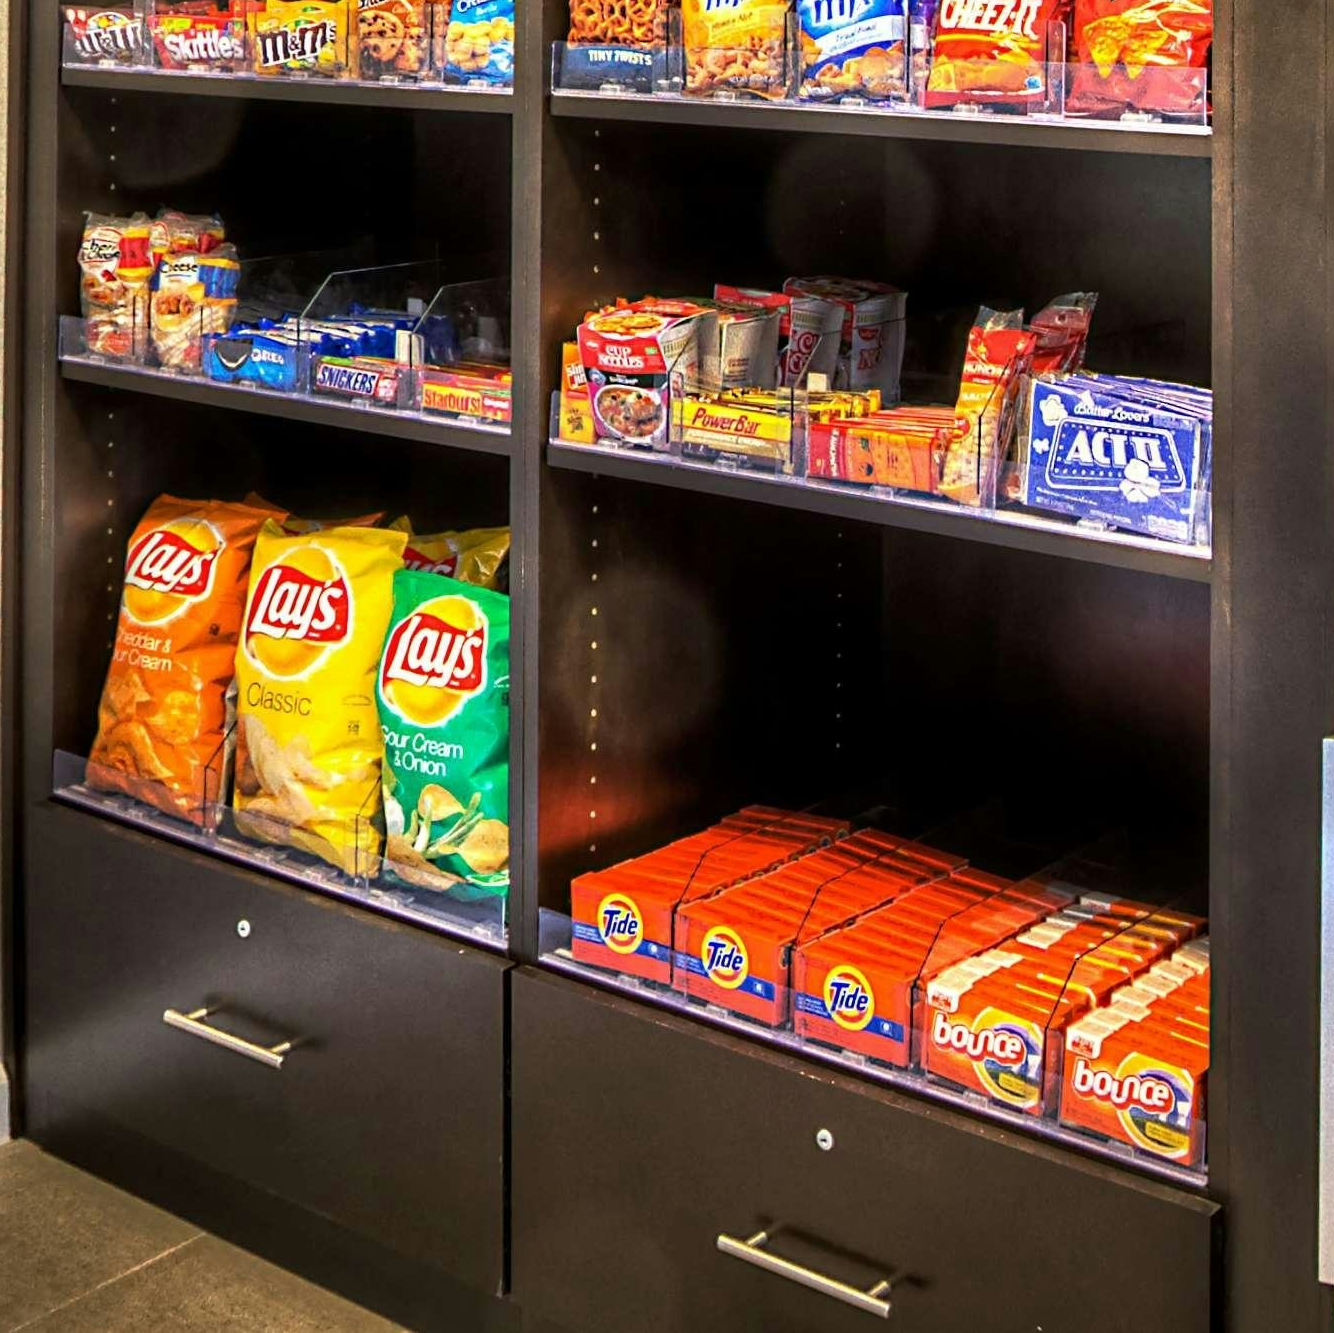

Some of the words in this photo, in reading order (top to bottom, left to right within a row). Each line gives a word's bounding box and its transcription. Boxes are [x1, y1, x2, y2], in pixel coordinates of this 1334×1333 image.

[164, 29, 245, 60] Skittles
[588, 49, 612, 63] TINY
[318, 365, 377, 395] SNICKERS
[424, 389, 481, 415] Starburst
[691, 407, 761, 437] PowerBar
[1063, 430, 1128, 469] ACT
[161, 639, 172, 652] &
[128, 651, 172, 672] Cream
[246, 681, 312, 717] Classic
[381, 726, 411, 750] Sour
[411, 732, 464, 760] Cream
[401, 753, 447, 777] Onion
[603, 909, 638, 937] Tide
[708, 941, 744, 971] Tide
[830, 981, 869, 1012] Tide
[933, 1013, 1022, 1059] bounce
[1074, 1059, 1170, 1107] bounce
